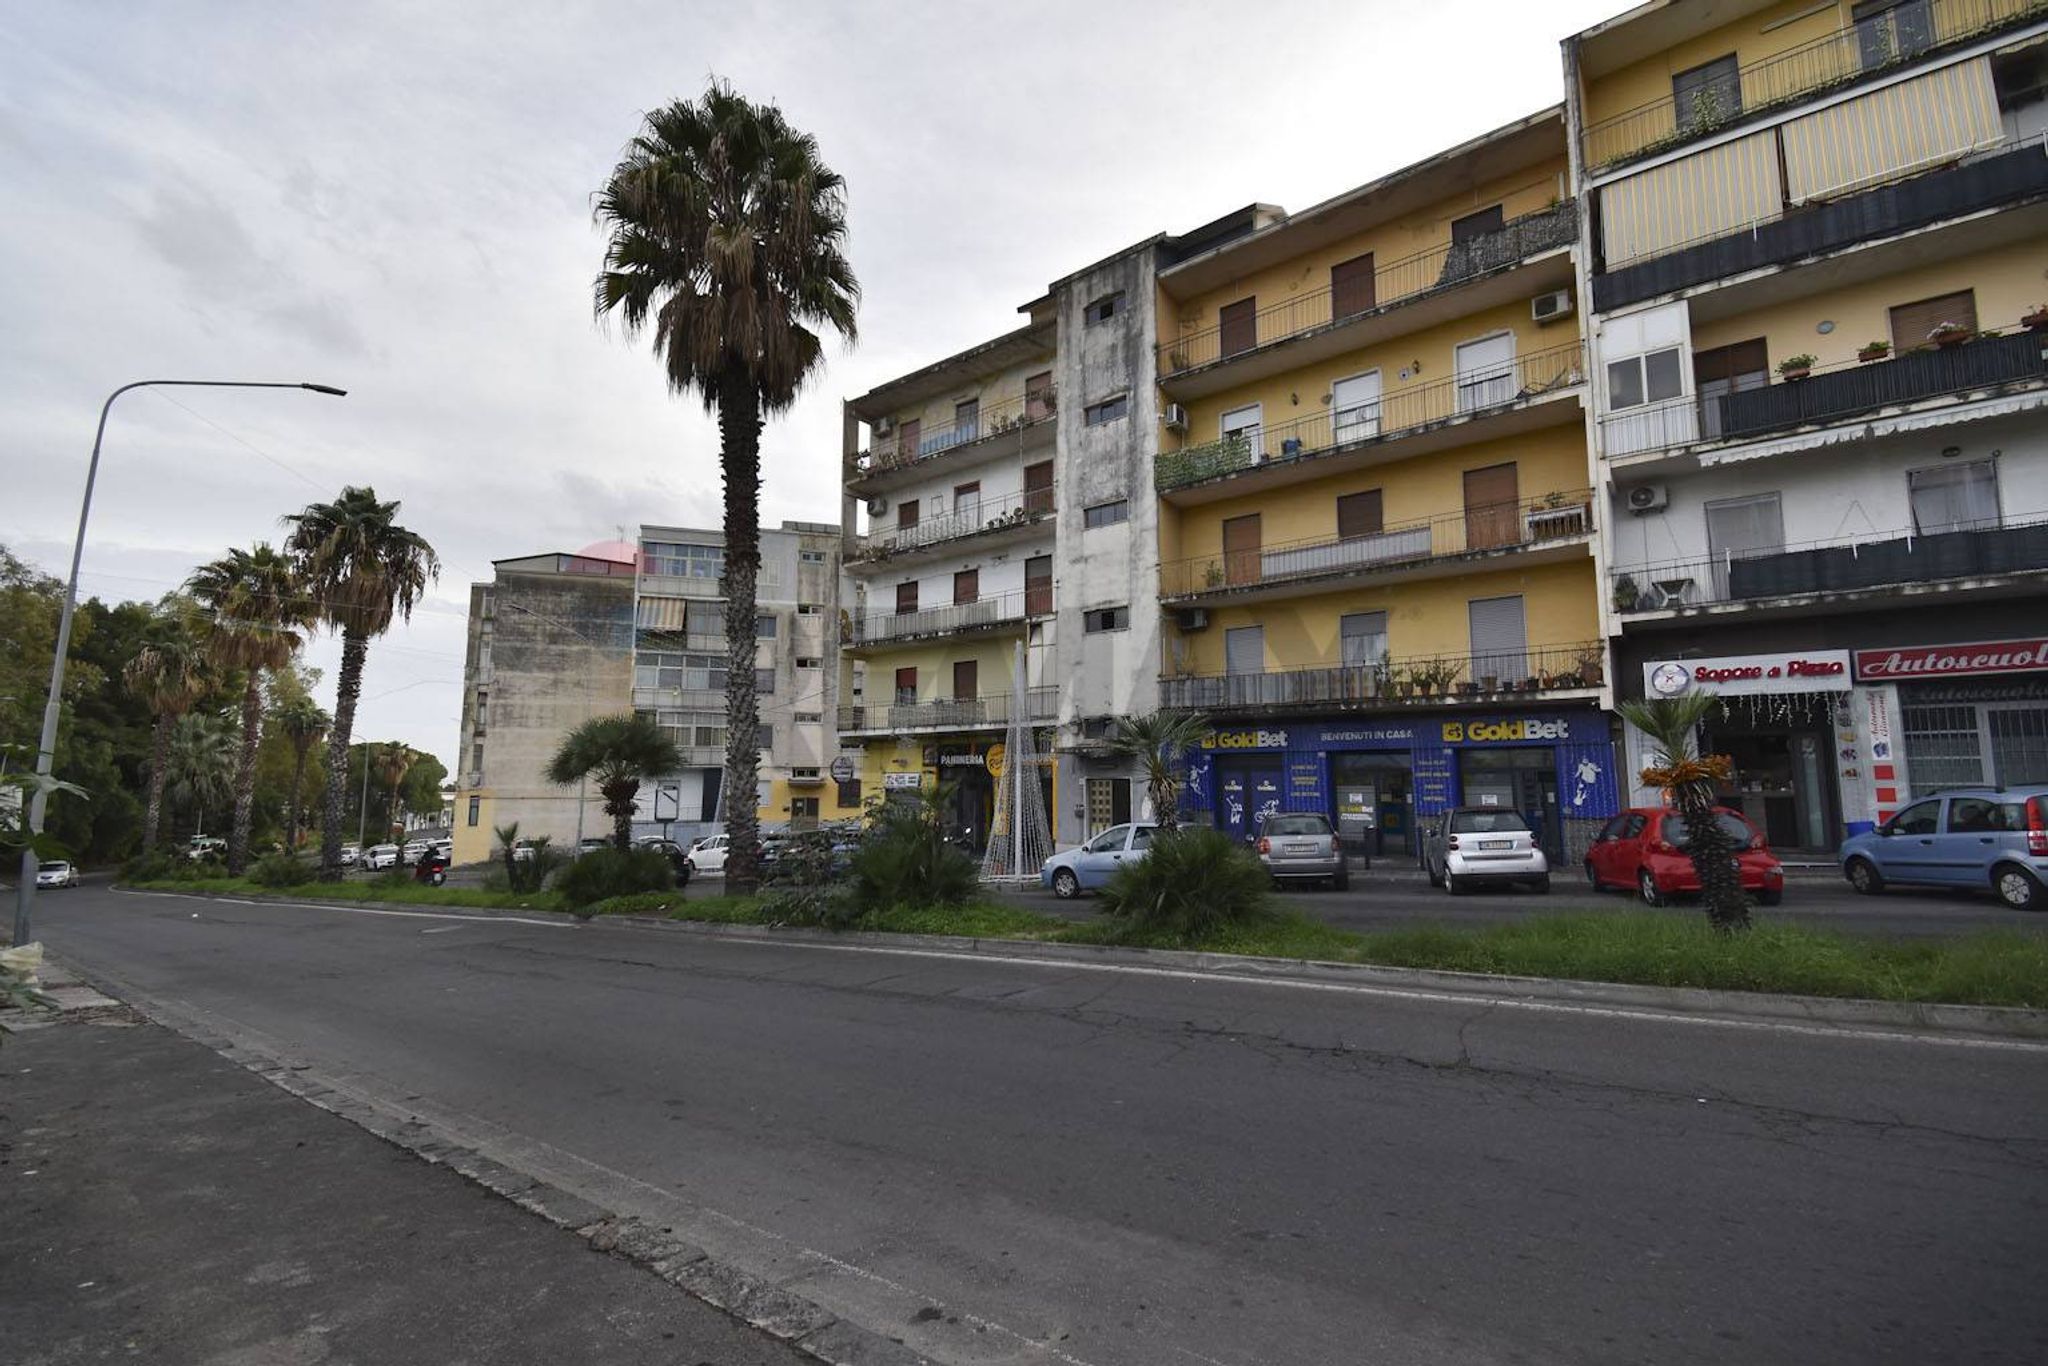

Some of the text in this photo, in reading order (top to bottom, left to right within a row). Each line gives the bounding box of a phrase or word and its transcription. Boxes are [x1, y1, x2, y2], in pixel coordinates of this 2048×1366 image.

[1693, 660, 1845, 684] Sapore di Pizza
[1321, 730, 1414, 742] BENVENUTI IN CASA
[1467, 719, 1570, 741] GoldBet
[1218, 731, 1288, 748] GoldBet
[940, 755, 984, 766] PANINERIA
